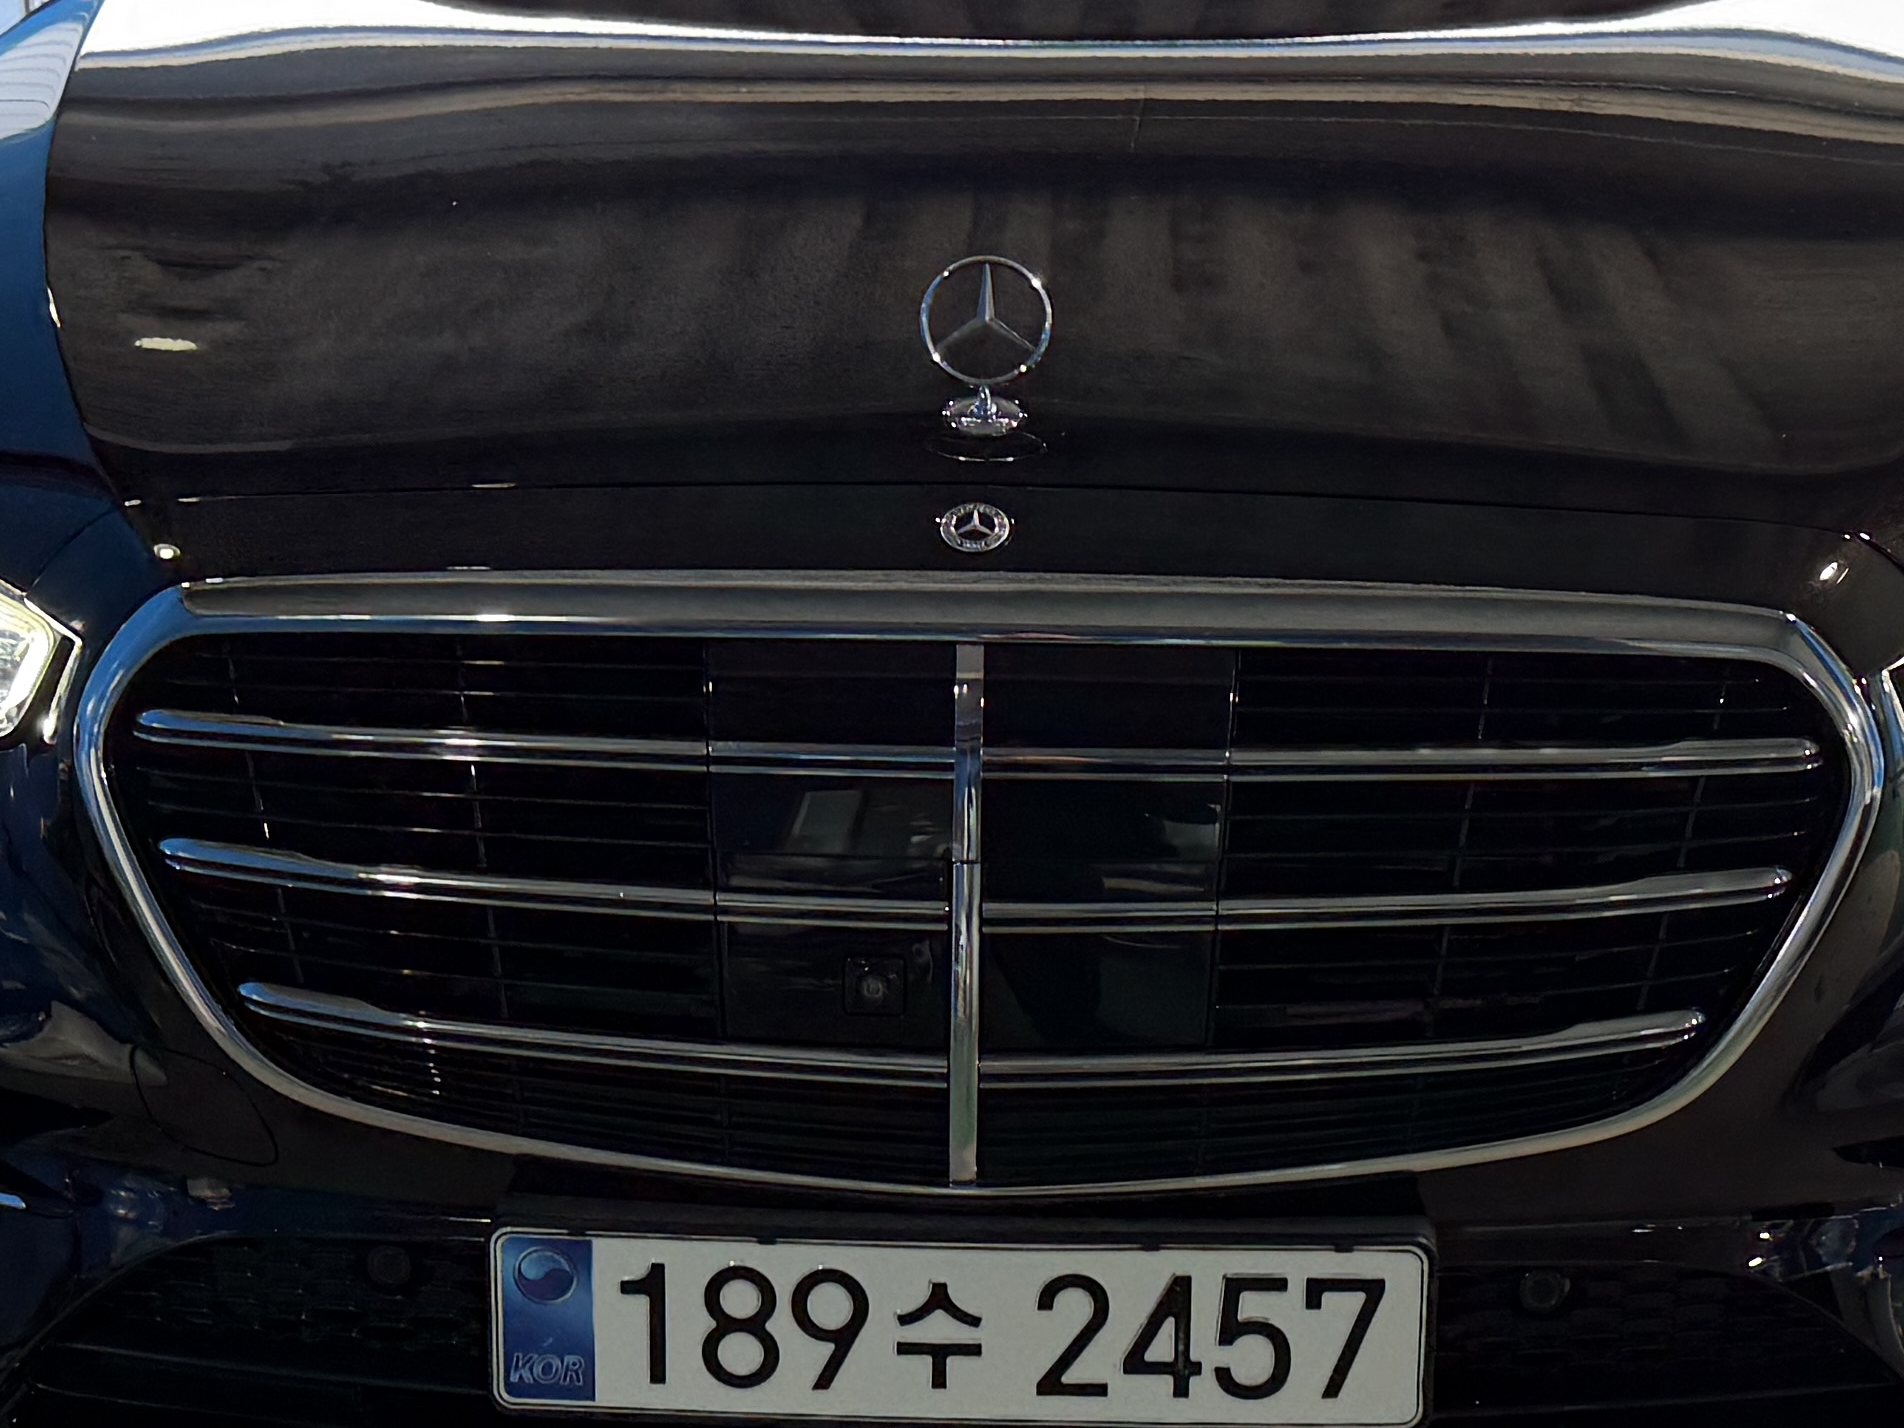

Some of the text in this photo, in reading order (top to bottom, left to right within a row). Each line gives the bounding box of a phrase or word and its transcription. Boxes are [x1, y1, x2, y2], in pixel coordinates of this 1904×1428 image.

[509, 1351, 585, 1386] KOR
[619, 1262, 1387, 1400] 189수 2457
